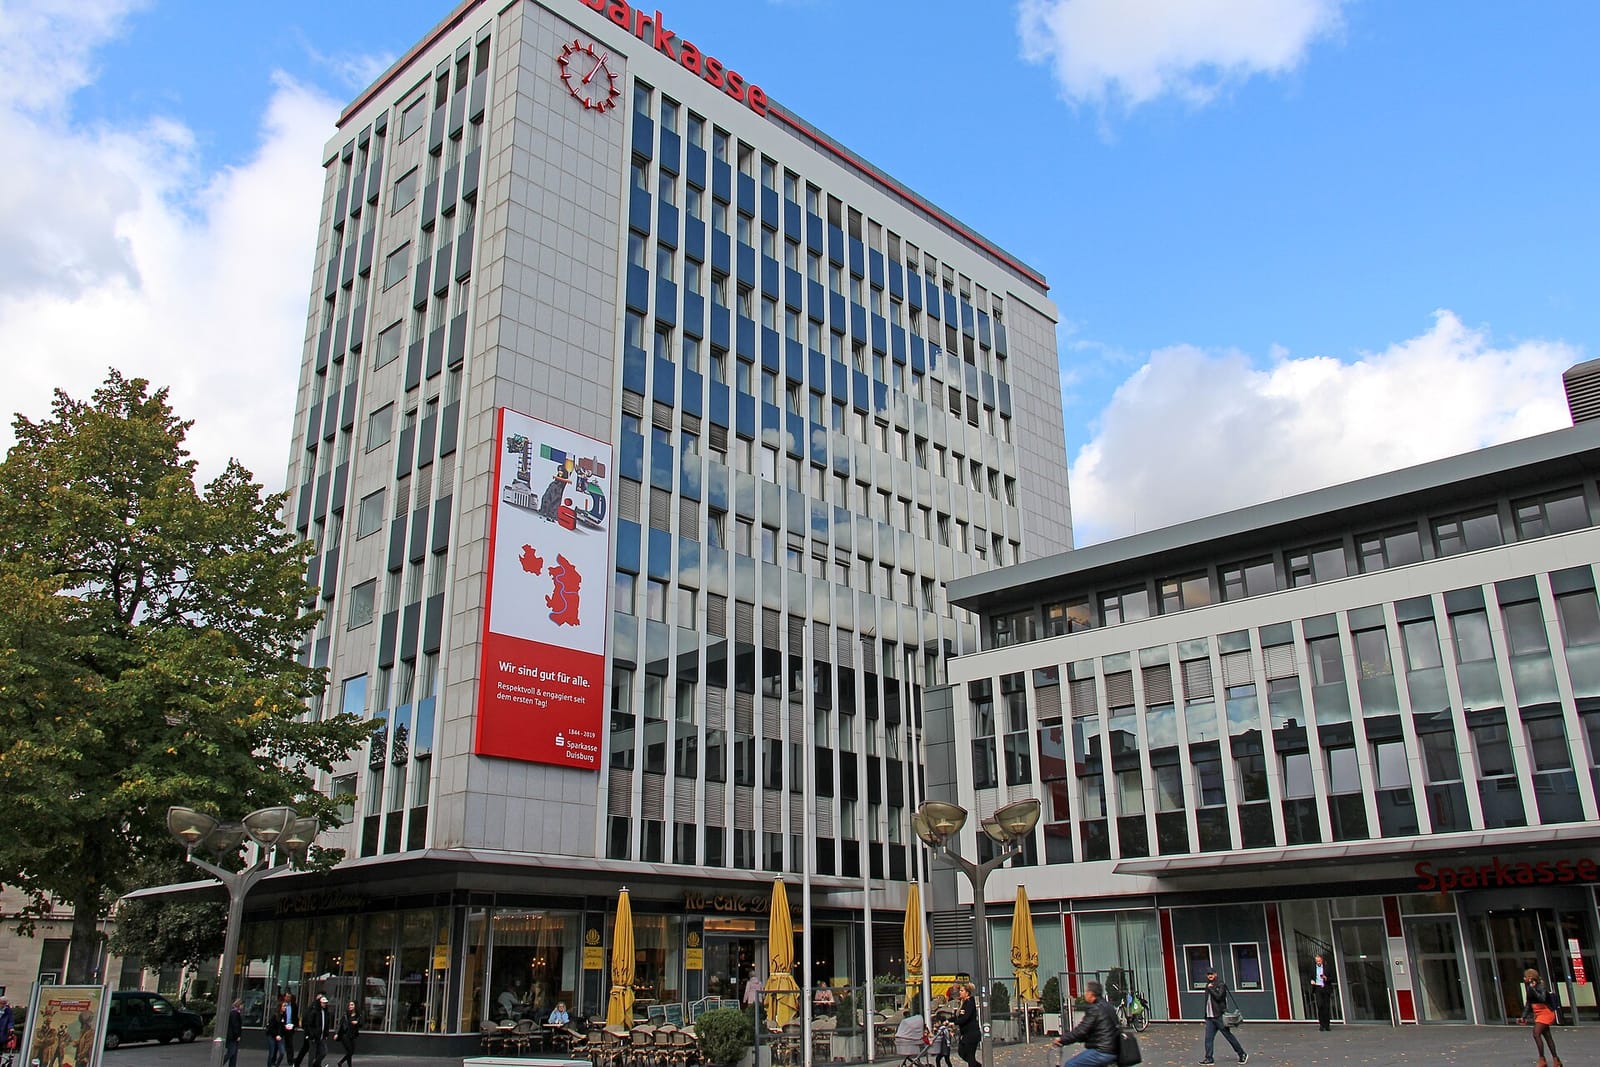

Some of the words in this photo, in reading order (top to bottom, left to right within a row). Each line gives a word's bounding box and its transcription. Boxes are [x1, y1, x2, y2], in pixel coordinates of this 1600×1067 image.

[499, 661, 516, 673] Wir
[518, 665, 537, 677] sind
[540, 671, 555, 681] gut
[557, 672, 571, 684] für
[572, 676, 590, 687] alle.
[497, 681, 535, 695] Respektvoll
[543, 691, 573, 702] engagiert
[573, 696, 586, 704] seit
[497, 692, 512, 701] dem
[513, 696, 533, 705] ersten
[534, 699, 548, 708] Tag!
[566, 740, 598, 752] Sparkasse
[566, 750, 594, 762] Duisburg
[1414, 856, 1597, 894] Sparkasse
